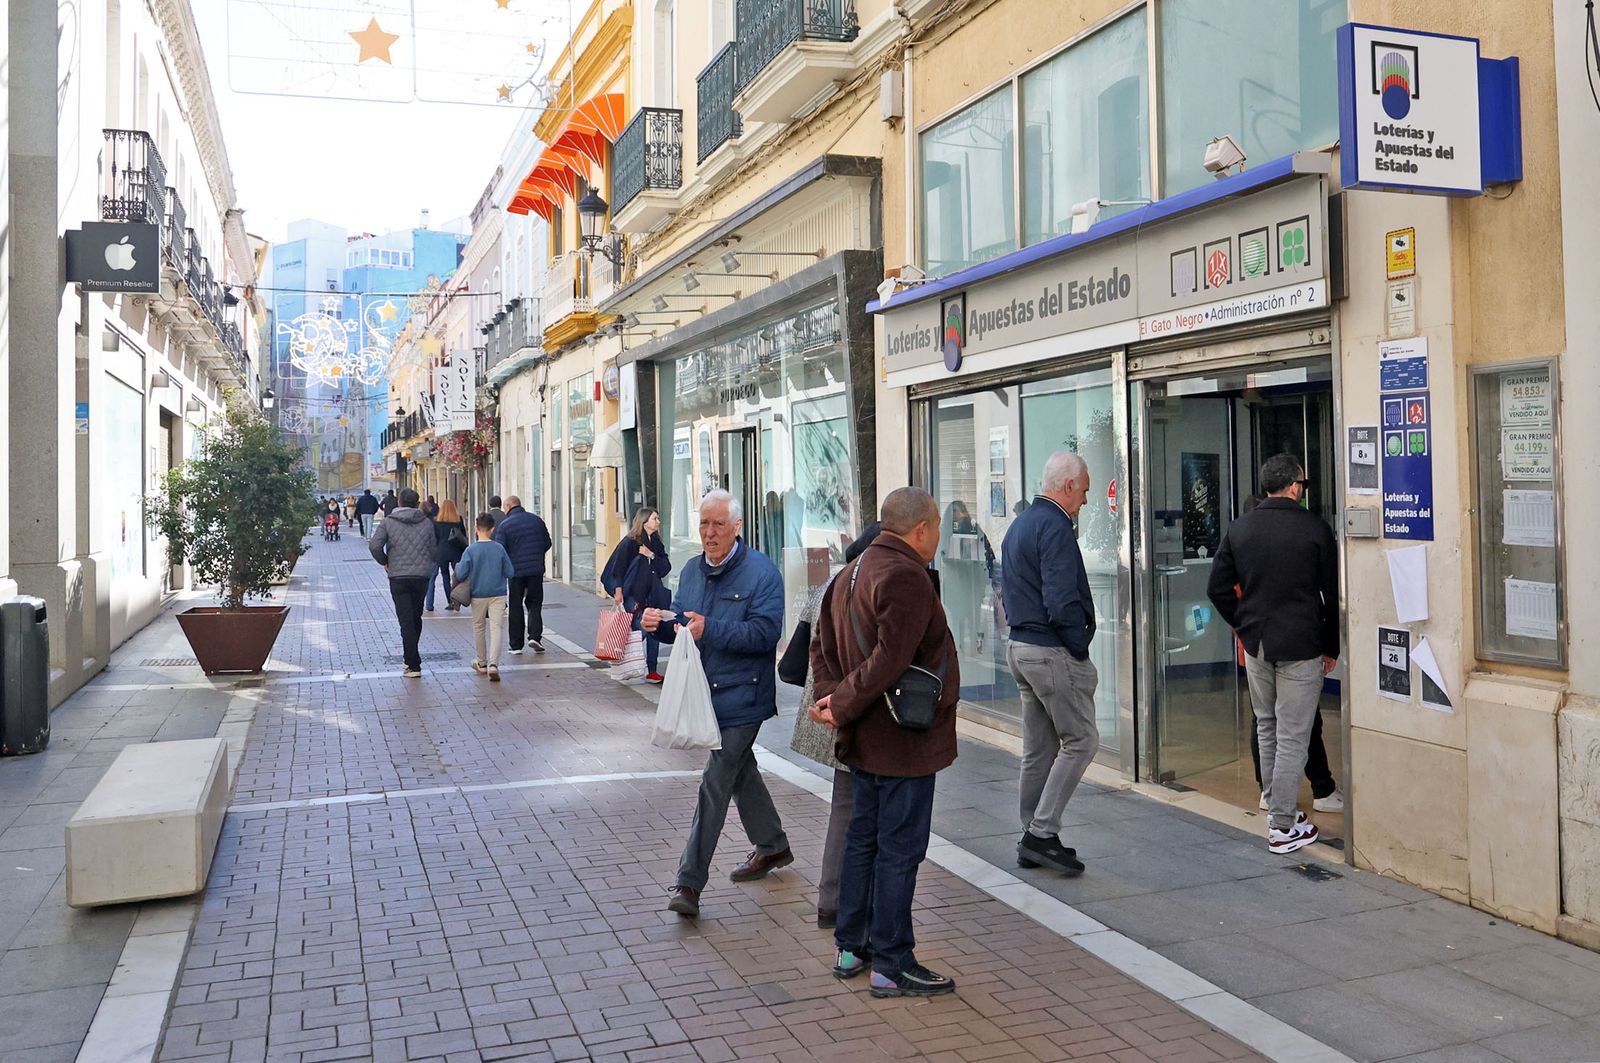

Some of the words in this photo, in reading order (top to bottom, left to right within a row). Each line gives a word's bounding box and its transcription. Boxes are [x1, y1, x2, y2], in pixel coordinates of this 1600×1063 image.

[1373, 121, 1425, 140] Loterías
[1426, 130, 1435, 144] y
[1375, 139, 1433, 158] Apuestas
[1435, 145, 1454, 160] del
[1375, 157, 1418, 174] Estado
[87, 279, 122, 287] Premium
[123, 279, 154, 288] Reseller
[968, 297, 1034, 341] Apuestas
[1038, 282, 1063, 319] del
[1067, 266, 1131, 312] Estado
[1139, 322, 1148, 335] El
[1151, 318, 1172, 333] Gato
[1175, 311, 1203, 330] Negro
[1210, 294, 1285, 321] Administración
[1308, 287, 1315, 302] 2
[887, 323, 931, 357] Loterías
[459, 357, 469, 410] NOVIAS
[1506, 377, 1525, 386] GRAN
[1525, 375, 1550, 384] PREMIO
[440, 374, 450, 419] NOVIAS
[1508, 410, 1533, 418] VENDIDO
[1357, 430, 1369, 440] BOTE
[1509, 433, 1527, 441] GRAN
[1528, 432, 1552, 440] PREMIO
[1511, 466, 1535, 474] VENDIDO
[1414, 494, 1420, 505] y
[1384, 508, 1418, 519] Apuestas
[1419, 507, 1431, 518] del
[1385, 523, 1410, 534] Estado
[1387, 632, 1400, 643] BOTE
[1388, 653, 1399, 663] 26
